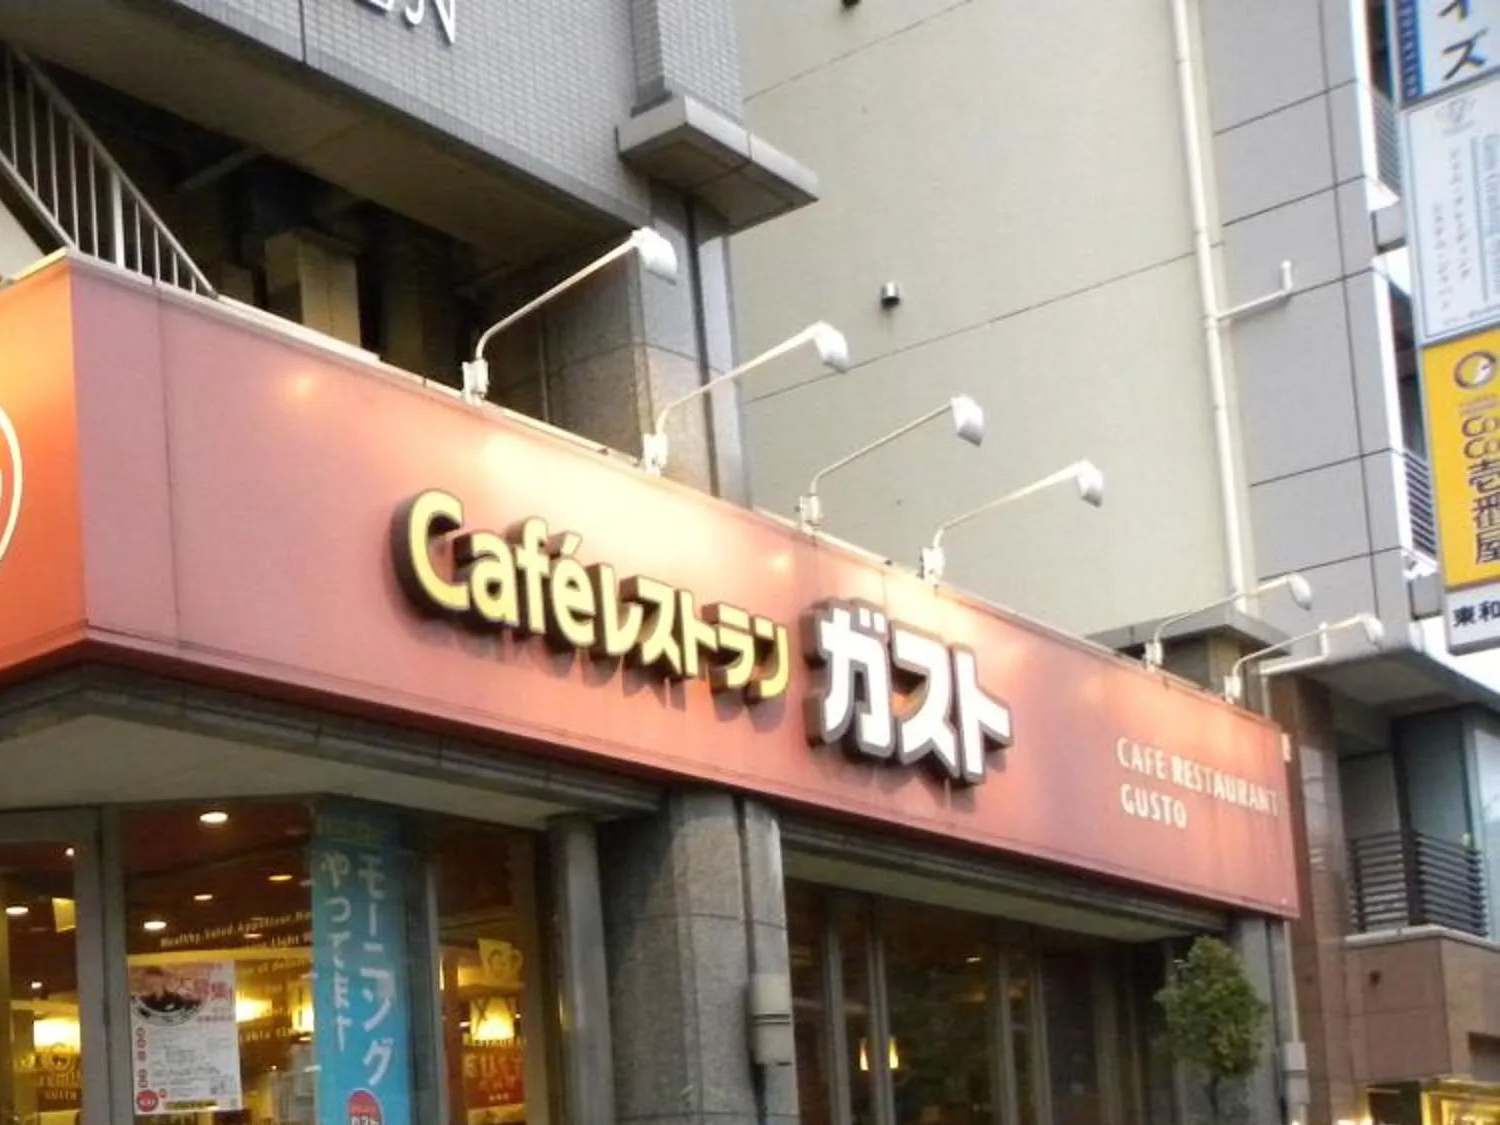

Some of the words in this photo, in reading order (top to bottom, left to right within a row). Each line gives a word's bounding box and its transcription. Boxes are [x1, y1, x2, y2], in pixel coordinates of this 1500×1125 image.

[817, 605, 1012, 784] ガスト
[1120, 783, 1188, 830] GUSTO
[1171, 755, 1279, 817] RESTAURANT
[357, 853, 396, 1087] モーニング
